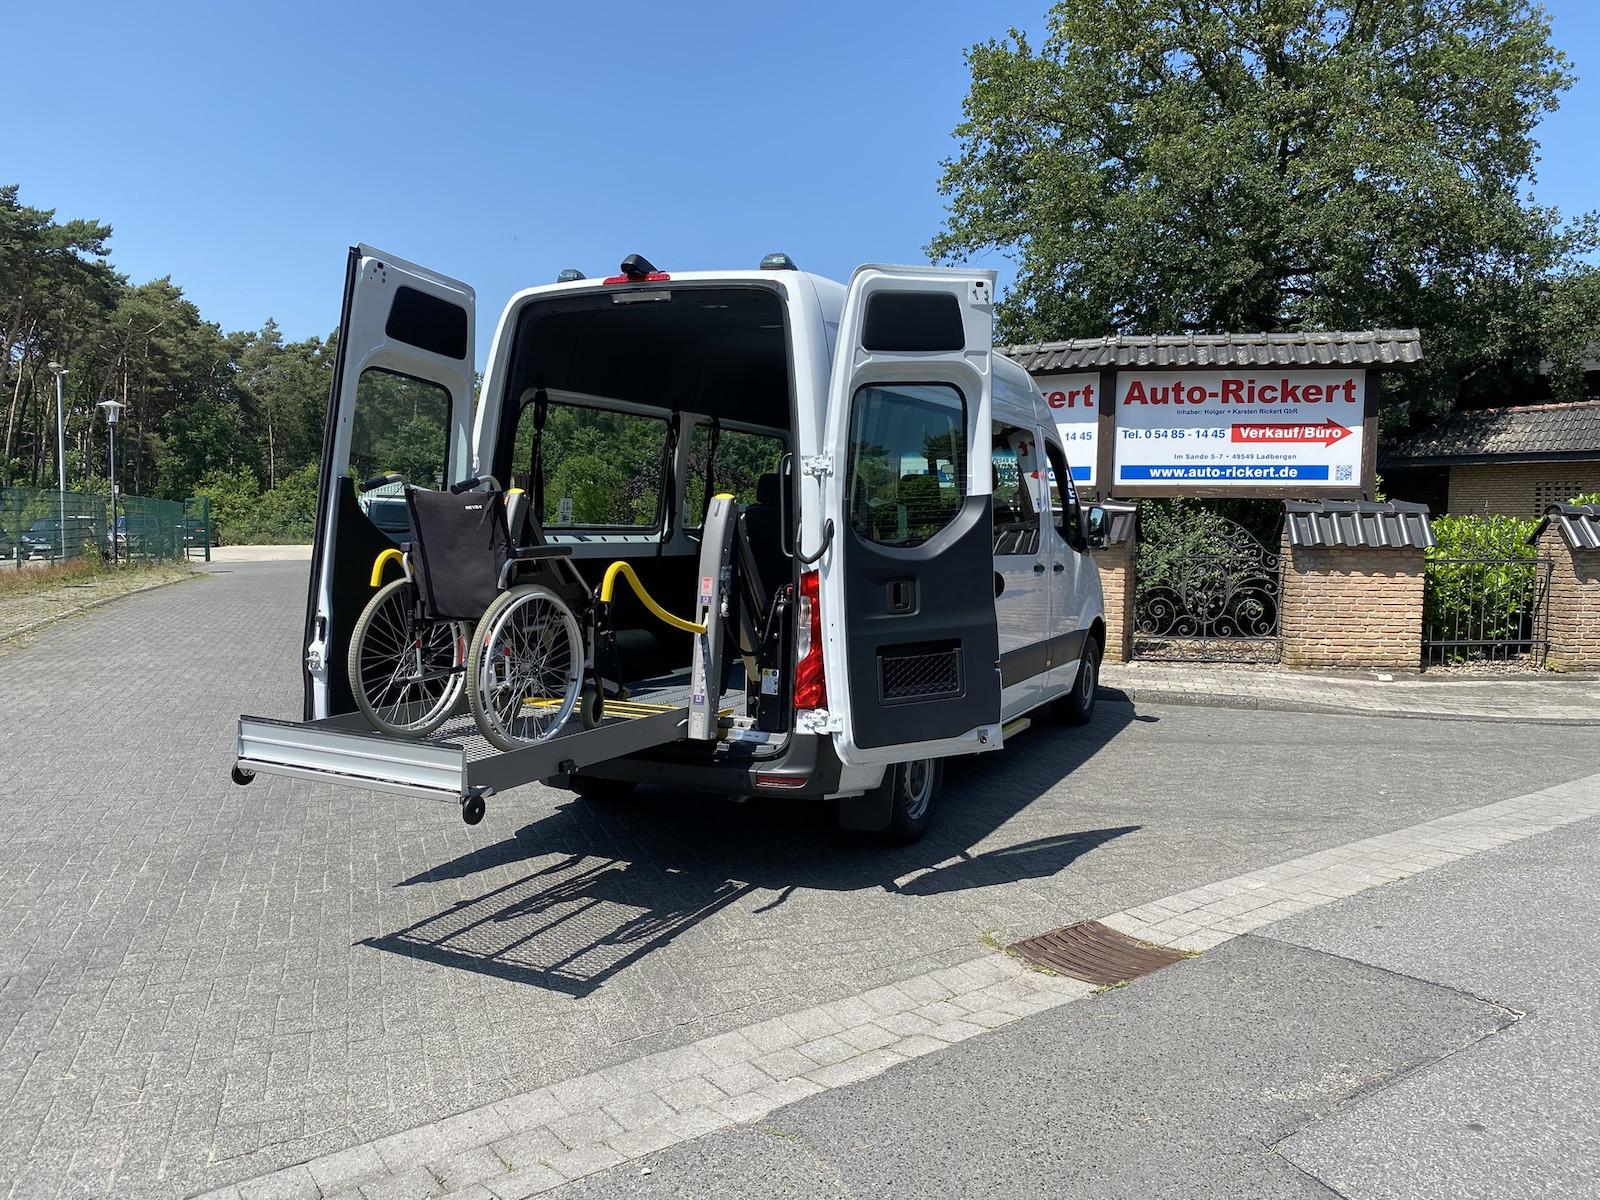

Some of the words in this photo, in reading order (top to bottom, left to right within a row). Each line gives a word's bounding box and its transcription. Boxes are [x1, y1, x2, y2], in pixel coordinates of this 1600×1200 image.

[1041, 384, 1094, 409] ert
[1123, 379, 1356, 405] Auto-Rickert
[1122, 430, 1142, 439] Tel.
[1240, 426, 1342, 438] Verkauf/Büro
[1256, 453, 1297, 461] Ladbergen
[1149, 467, 1298, 478] www.auto-rickert.de
